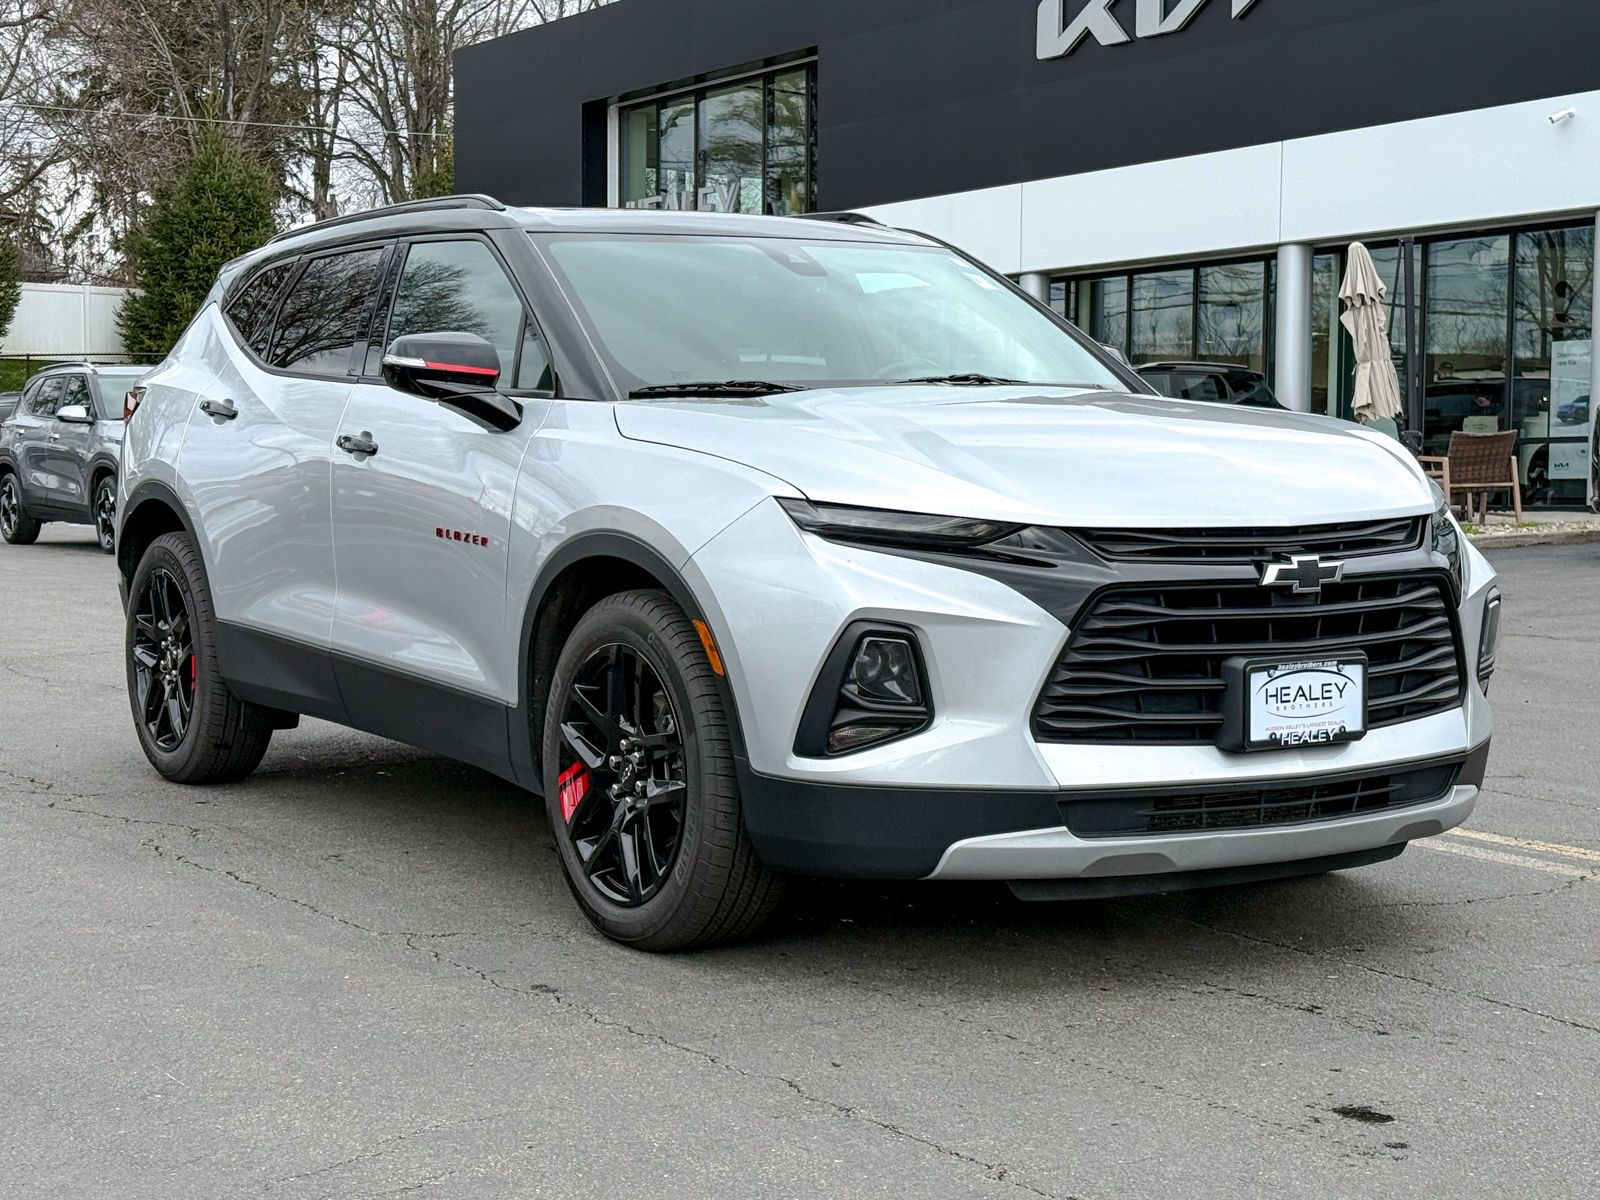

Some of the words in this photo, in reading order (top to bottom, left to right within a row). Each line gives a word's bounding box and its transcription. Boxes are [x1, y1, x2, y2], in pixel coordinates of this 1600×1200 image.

[436, 527, 489, 548] BLAZER
[1277, 660, 1338, 671] healeybrothers.com
[1265, 681, 1348, 705] HEALEY
[1276, 701, 1333, 712] BROTHERS
[1280, 728, 1336, 746] HEALEY
